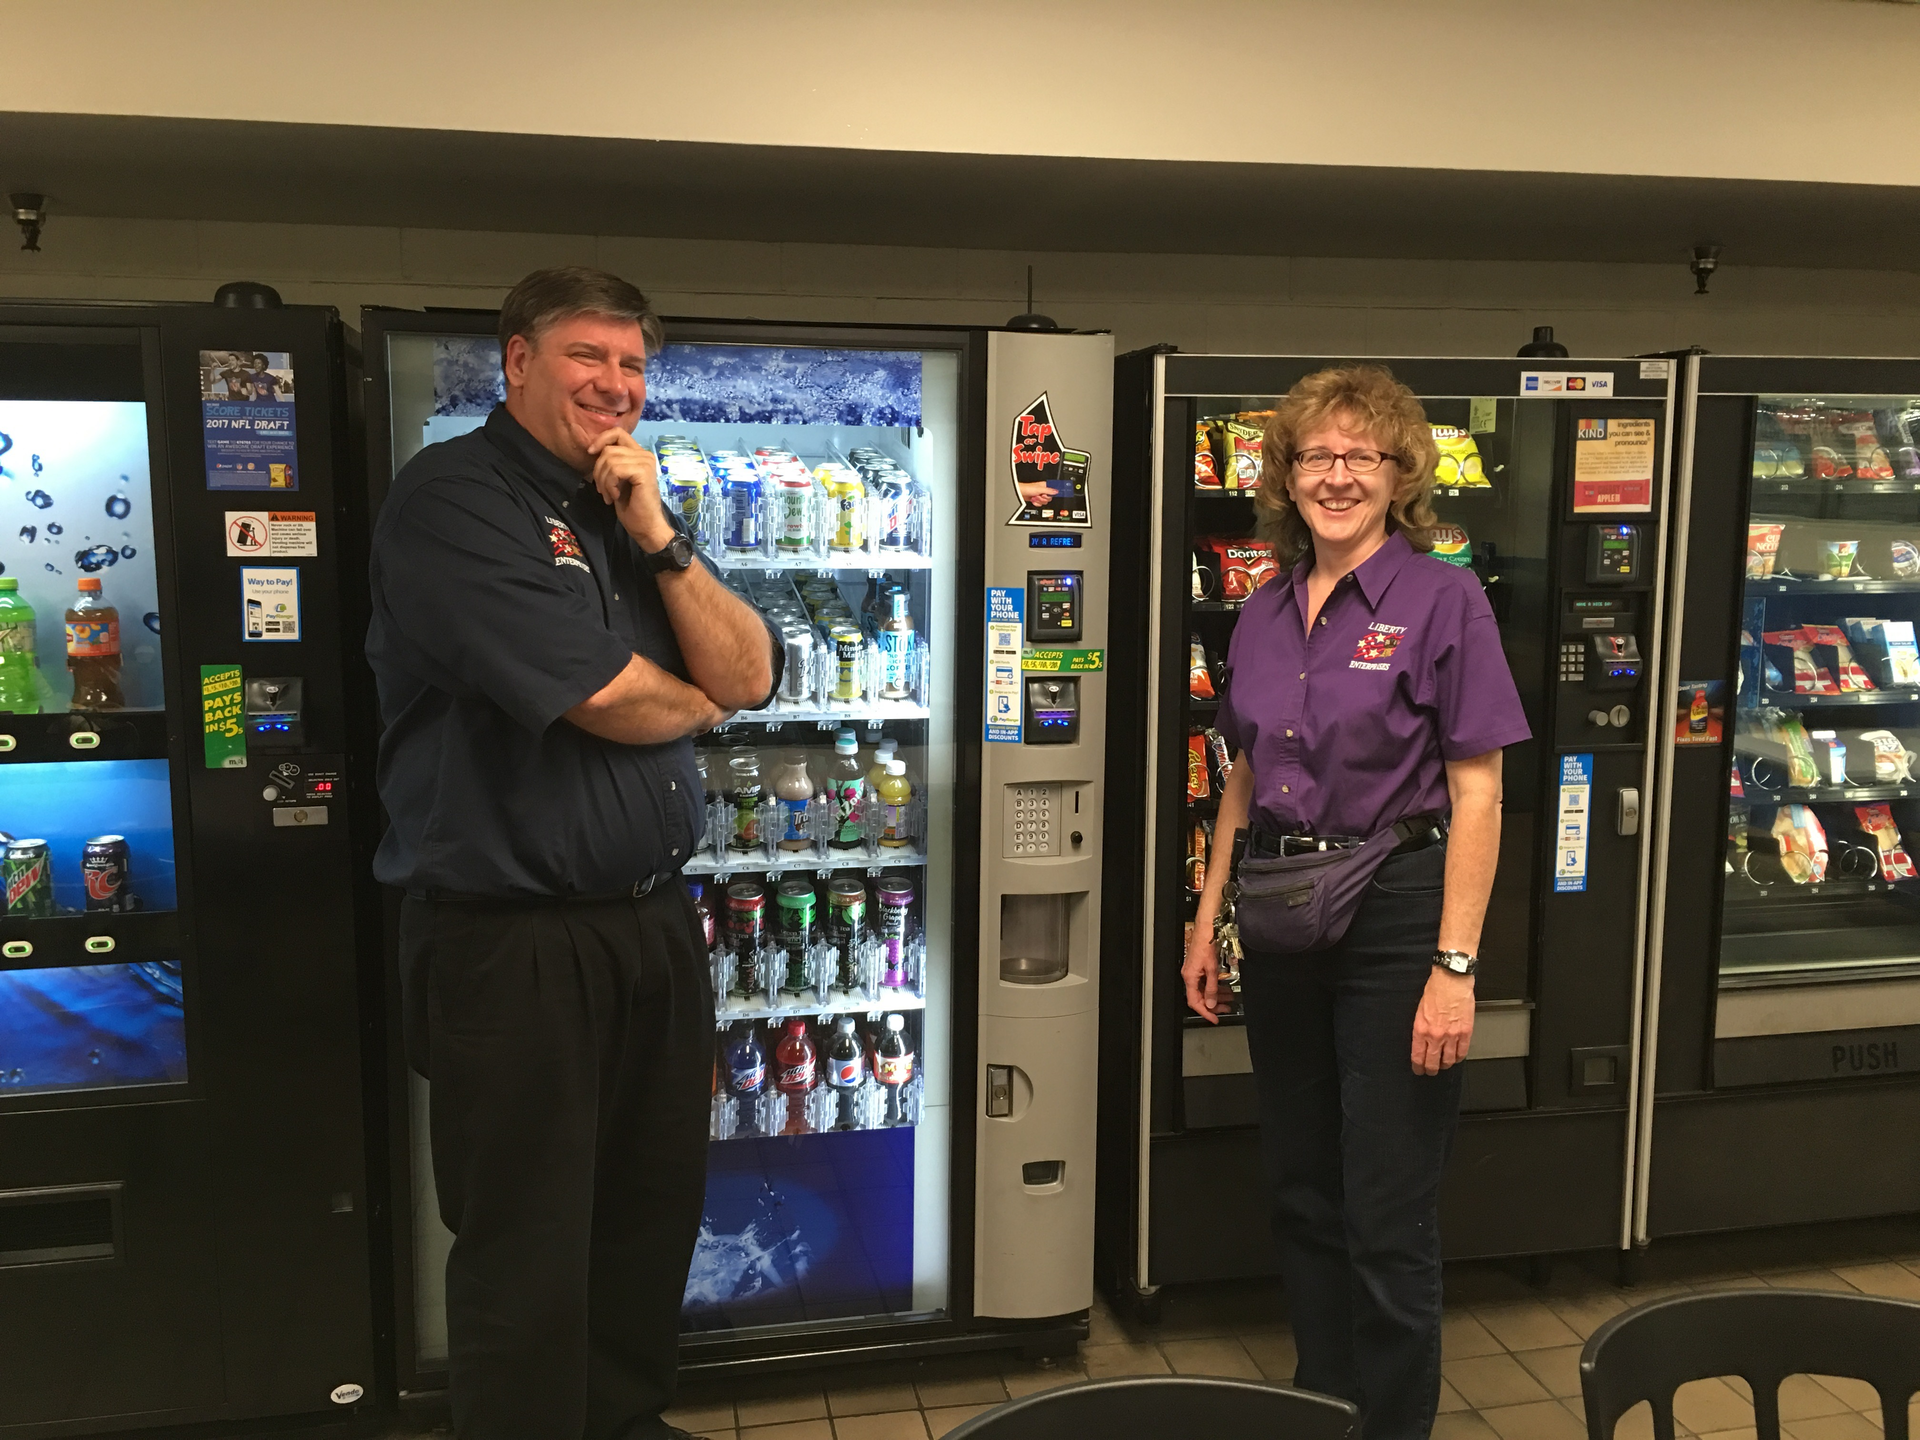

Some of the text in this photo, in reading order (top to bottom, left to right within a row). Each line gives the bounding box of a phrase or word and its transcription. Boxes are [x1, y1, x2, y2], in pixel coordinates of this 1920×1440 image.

[206, 406, 289, 417] SCORE TICKETS
[206, 419, 289, 429] 2017 NFL DRAFT
[1019, 414, 1053, 443] Tap
[1617, 420, 1650, 428] ingredients
[1578, 428, 1605, 438] KIND
[1013, 443, 1060, 471] Swipe
[1227, 550, 1272, 558] Doritos
[248, 578, 265, 586] Way
[276, 579, 292, 587] Pay!
[1368, 622, 1408, 634] LIBERTY
[1349, 660, 1391, 671] ENTERPRISES
[203, 670, 240, 684] ACCEPTS
[204, 692, 242, 711] PAYS
[205, 705, 242, 722] BACK
[205, 722, 218, 733] IN
[734, 785, 761, 794] AMP
[84, 866, 122, 900] RC
[1832, 1042, 1898, 1073] PUSH
[335, 1389, 360, 1399] Vendo
